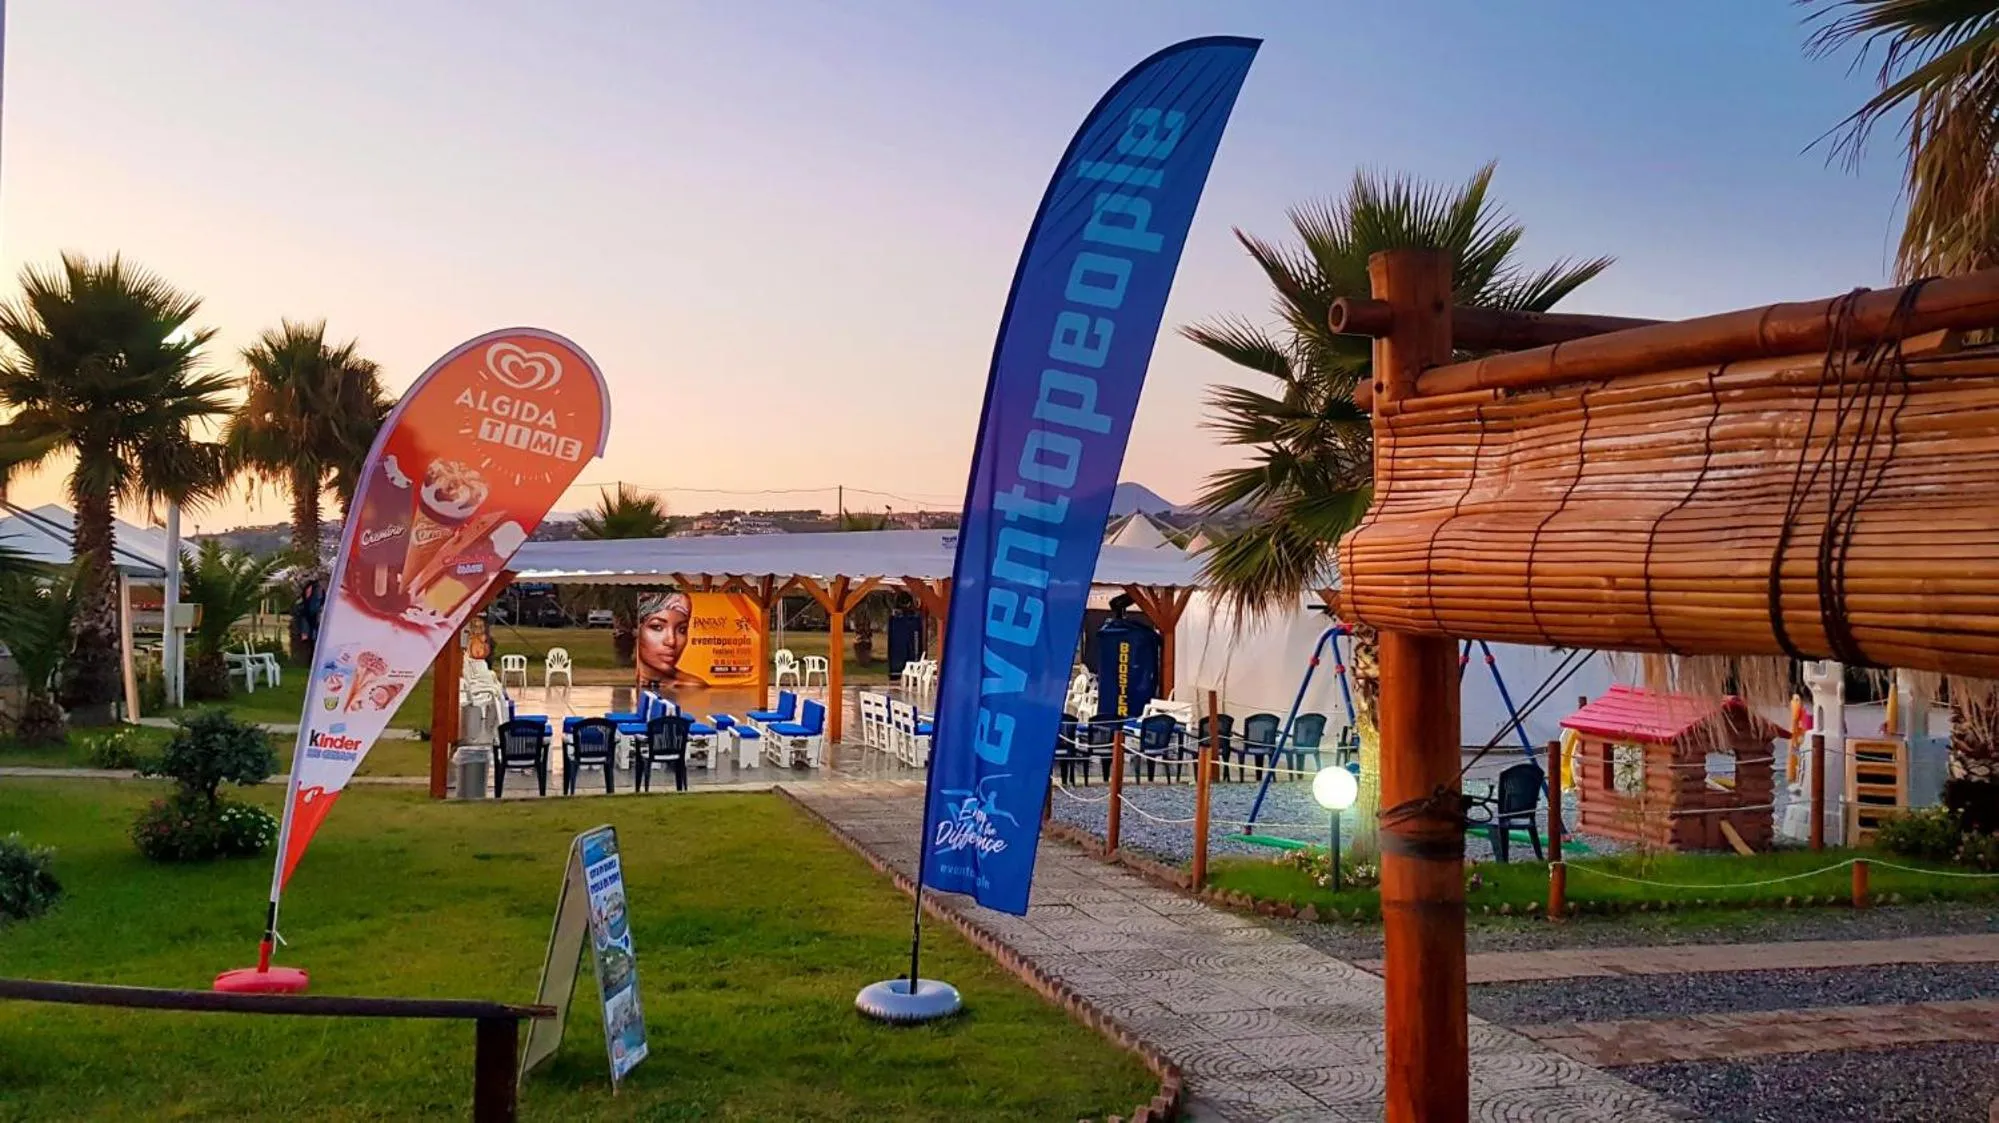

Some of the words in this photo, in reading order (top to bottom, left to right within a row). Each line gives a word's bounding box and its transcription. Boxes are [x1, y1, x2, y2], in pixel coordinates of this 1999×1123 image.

[455, 386, 558, 430] ALGIDA
[479, 418, 583, 462] TIME
[974, 107, 1186, 765] eventopeople
[1117, 642, 1130, 717] BOOSTER
[935, 820, 1008, 853] Diffeence
